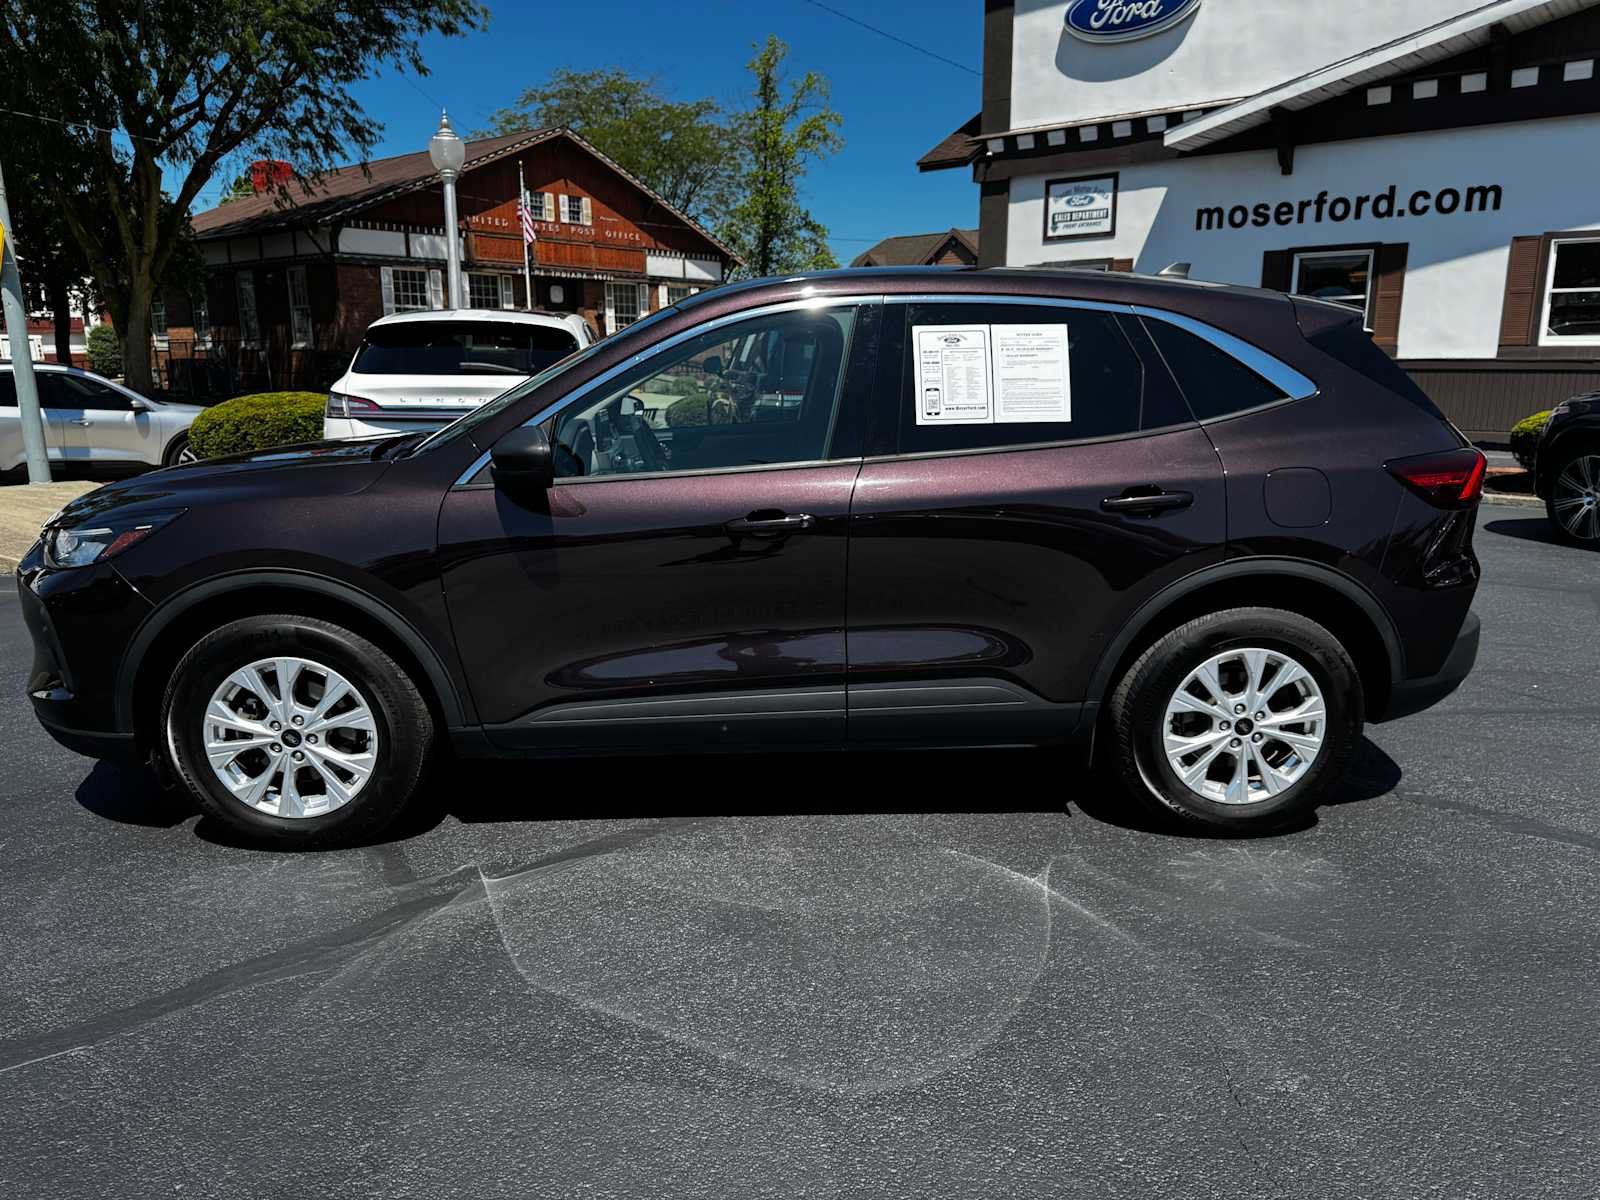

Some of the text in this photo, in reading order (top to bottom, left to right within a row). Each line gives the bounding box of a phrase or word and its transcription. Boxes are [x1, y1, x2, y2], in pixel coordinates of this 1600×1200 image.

[1090, 0, 1163, 29] Ford
[1196, 184, 1503, 231] moserford.com
[519, 221, 560, 233] SATES
[570, 226, 595, 236] POST
[605, 230, 640, 240] OFFICE
